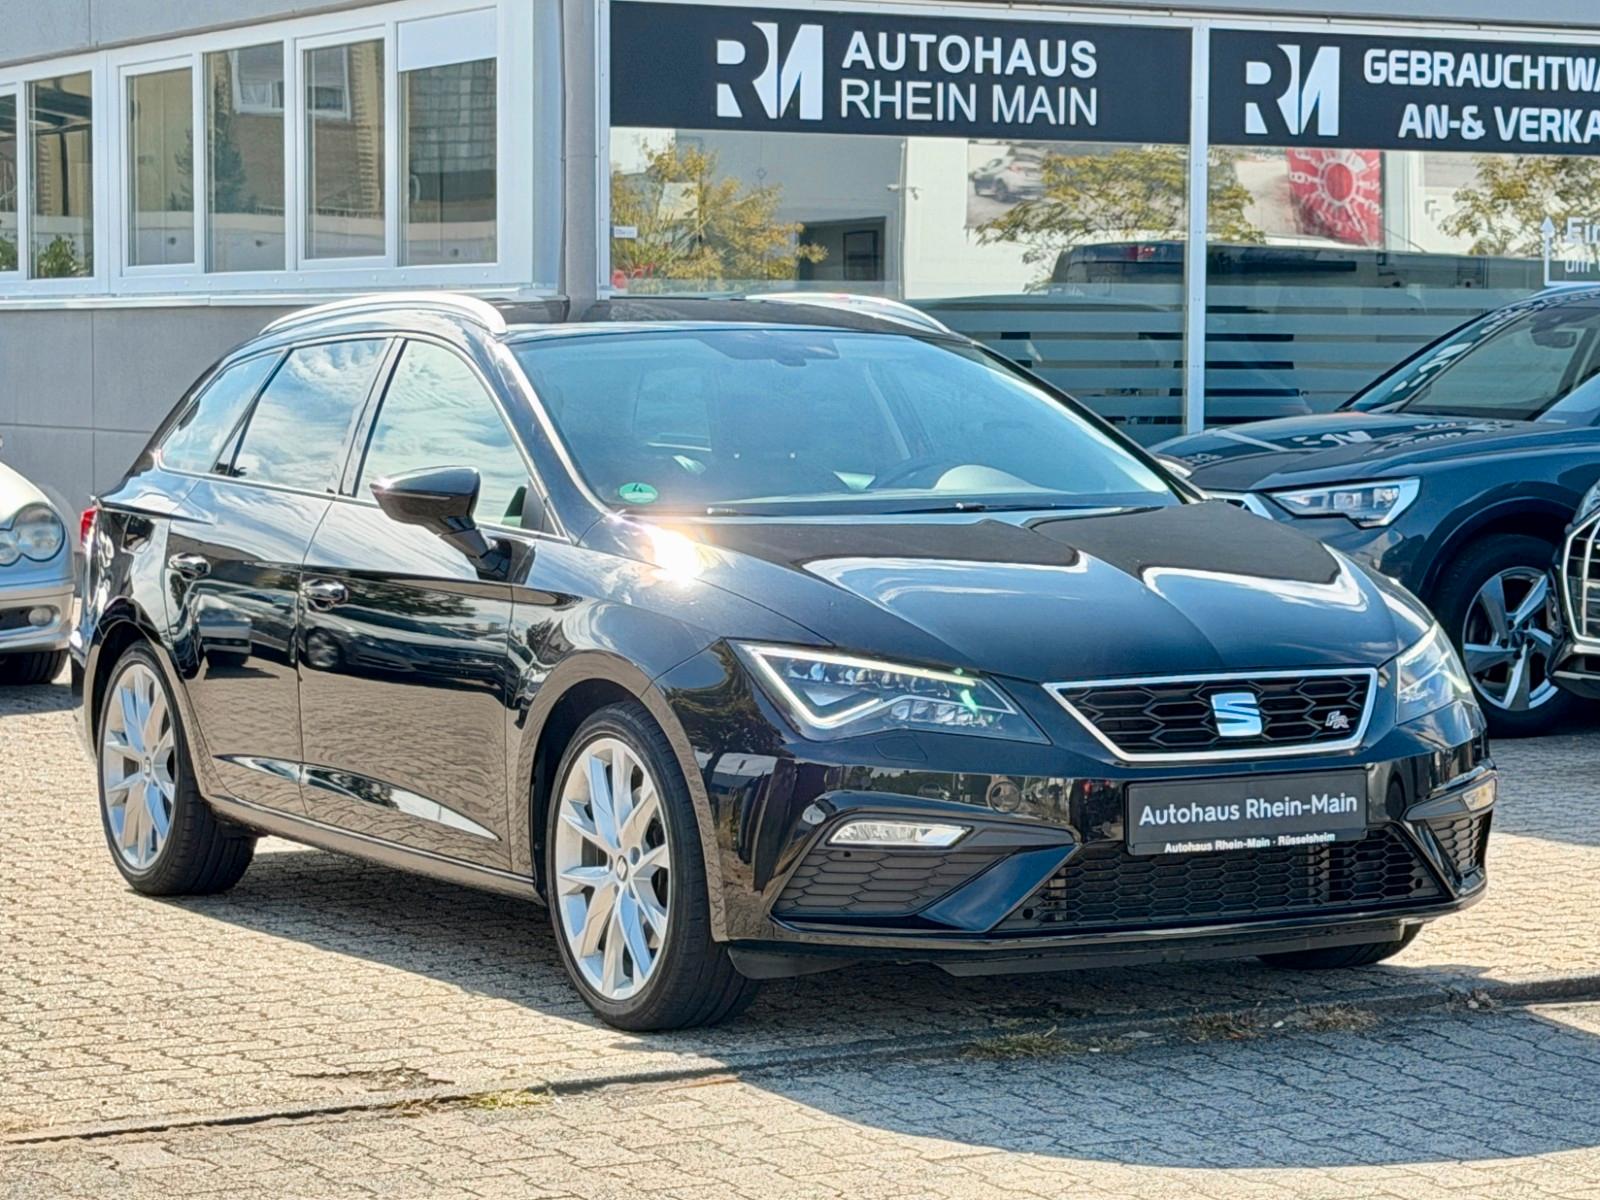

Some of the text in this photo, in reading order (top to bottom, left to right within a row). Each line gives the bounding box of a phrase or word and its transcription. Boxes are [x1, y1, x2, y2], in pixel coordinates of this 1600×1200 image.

[841, 31, 1098, 79] AUTOHAUS
[1363, 48, 1600, 92] GEBRAUCHTW
[840, 78, 1098, 126] RHEIN MAIN
[1494, 106, 1600, 144] VERKA
[1139, 792, 1357, 826] Autohaus Rhein-Main
[1164, 832, 1336, 853] Autohaus Rhein-Main Rüsselsheim
